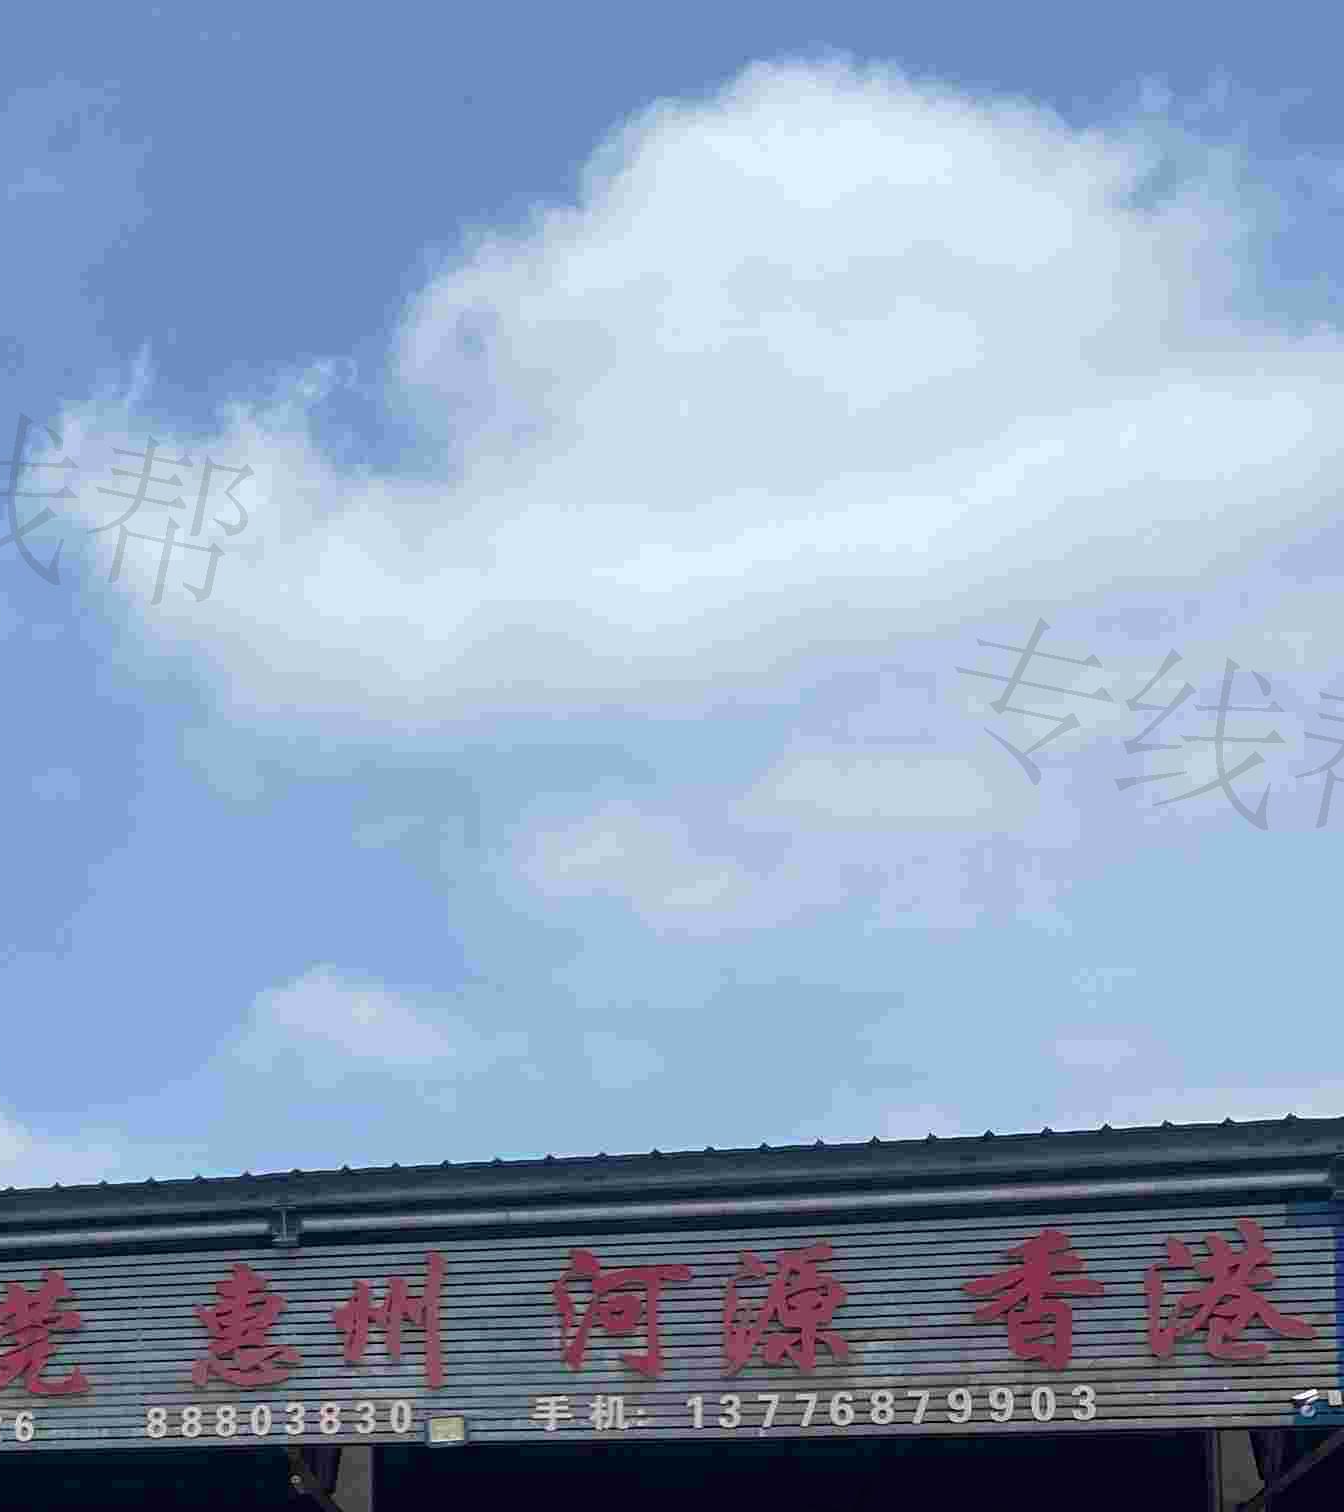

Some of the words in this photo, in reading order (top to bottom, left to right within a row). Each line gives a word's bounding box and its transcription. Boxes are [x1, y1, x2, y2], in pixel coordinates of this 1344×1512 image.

[191, 1248, 450, 1393] 惠州
[550, 1241, 853, 1380] 河源
[960, 1217, 1318, 1372] 香港
[145, 1400, 413, 1439] 88803830
[686, 1383, 1100, 1431] 13776879903
